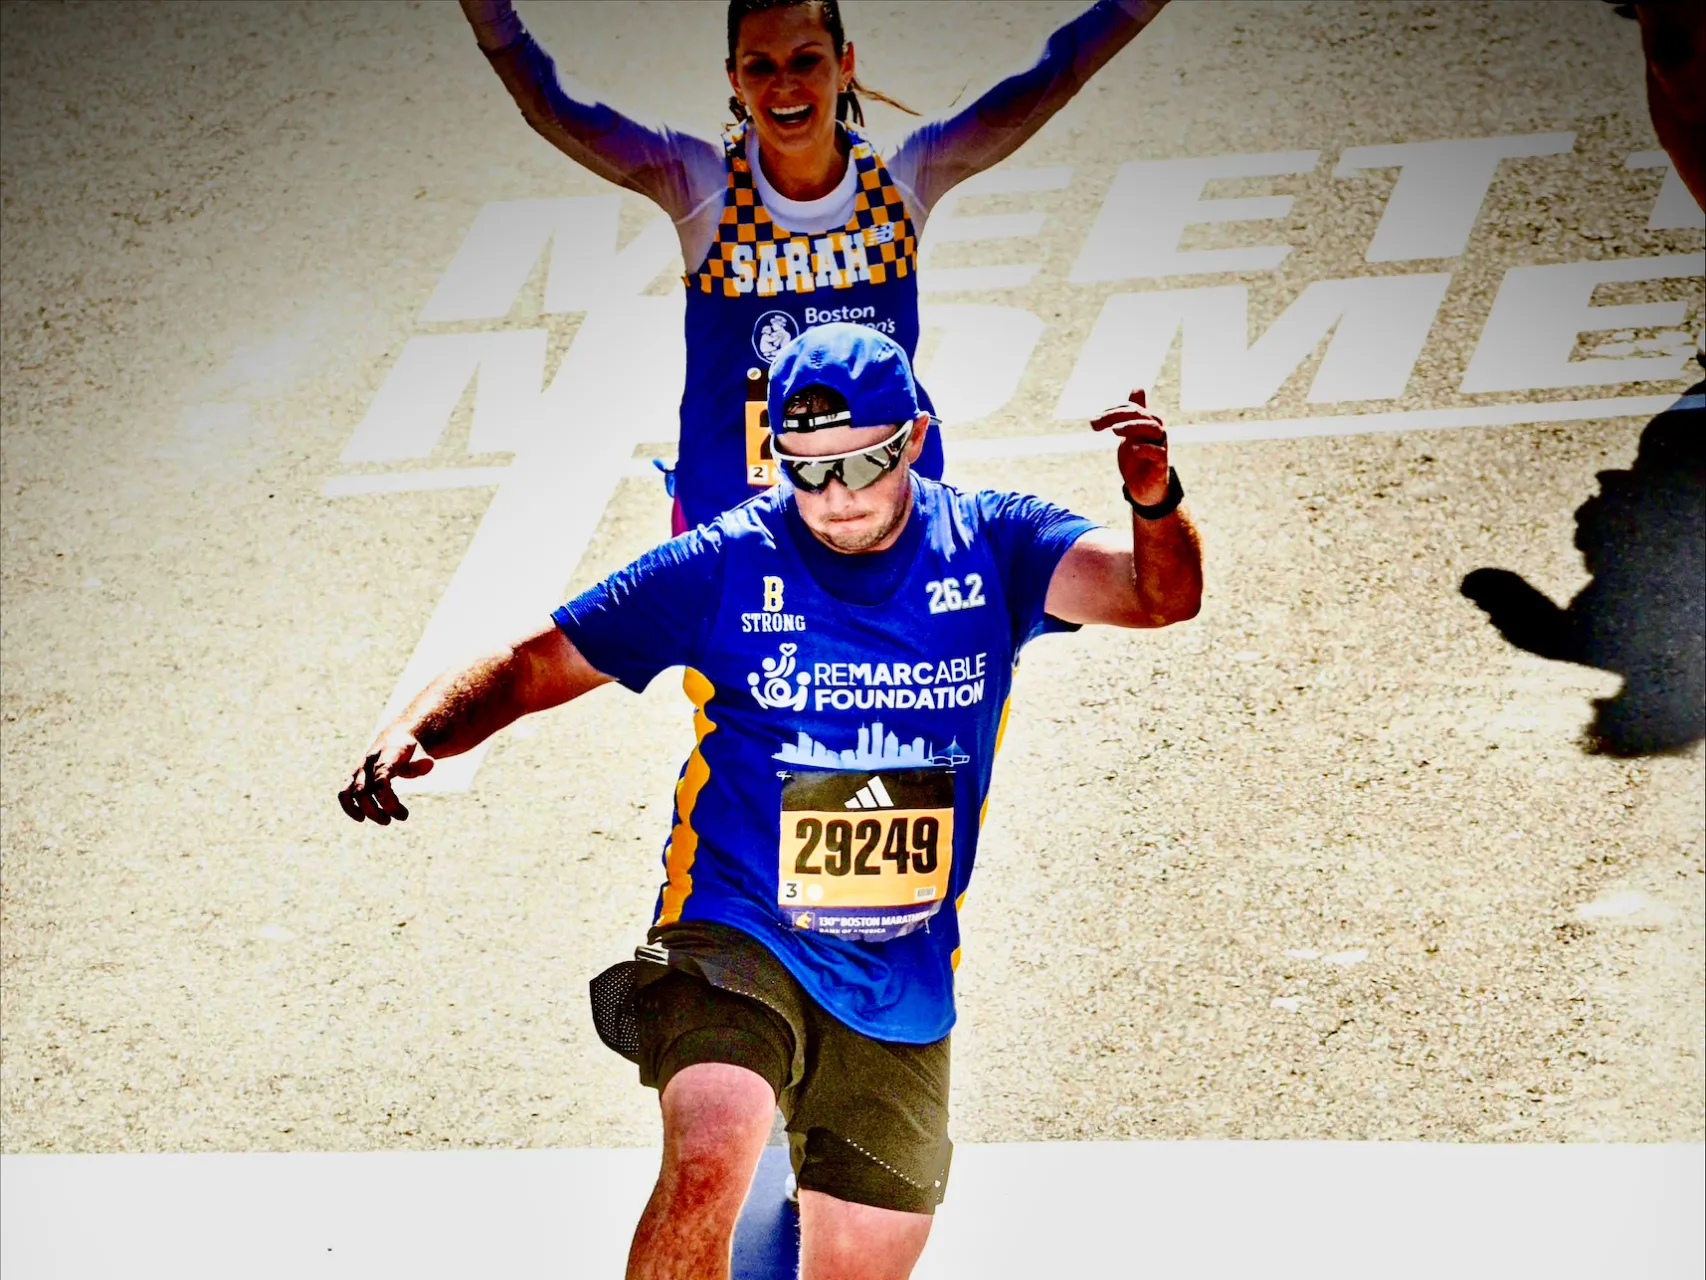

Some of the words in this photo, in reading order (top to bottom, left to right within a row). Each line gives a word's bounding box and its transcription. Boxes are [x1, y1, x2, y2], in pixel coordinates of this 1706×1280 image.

[731, 232, 872, 294] SARAH
[805, 306, 875, 324] Boston
[753, 466, 764, 478] 2
[762, 575, 784, 613] B
[925, 573, 986, 615] 26.2
[741, 612, 806, 633] STRONG
[814, 653, 987, 686] REMARCABLE
[815, 679, 985, 712] FOUNDATION
[794, 816, 940, 877] 29249
[785, 883, 798, 898] 3
[840, 916, 881, 926] BOSTON
